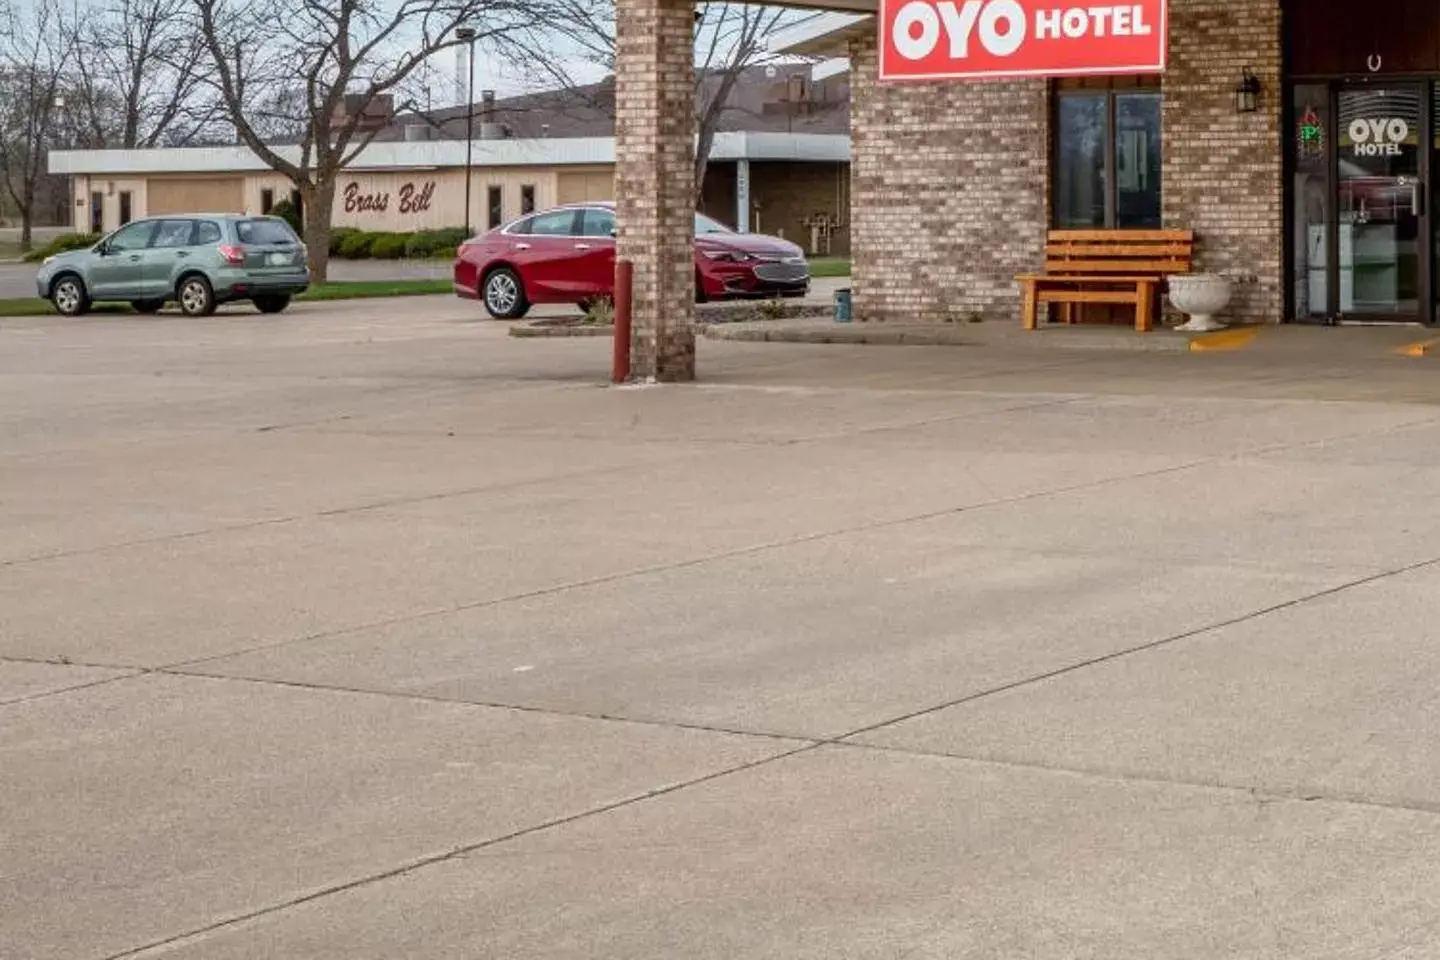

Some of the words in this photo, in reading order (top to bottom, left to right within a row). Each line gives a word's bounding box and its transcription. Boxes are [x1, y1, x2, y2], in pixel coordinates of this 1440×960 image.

[1035, 5, 1151, 39] HOTEL
[1349, 118, 1408, 142] OYO
[1354, 143, 1402, 156] HOTEL
[344, 181, 390, 212] Brass
[399, 181, 436, 213] Bell
